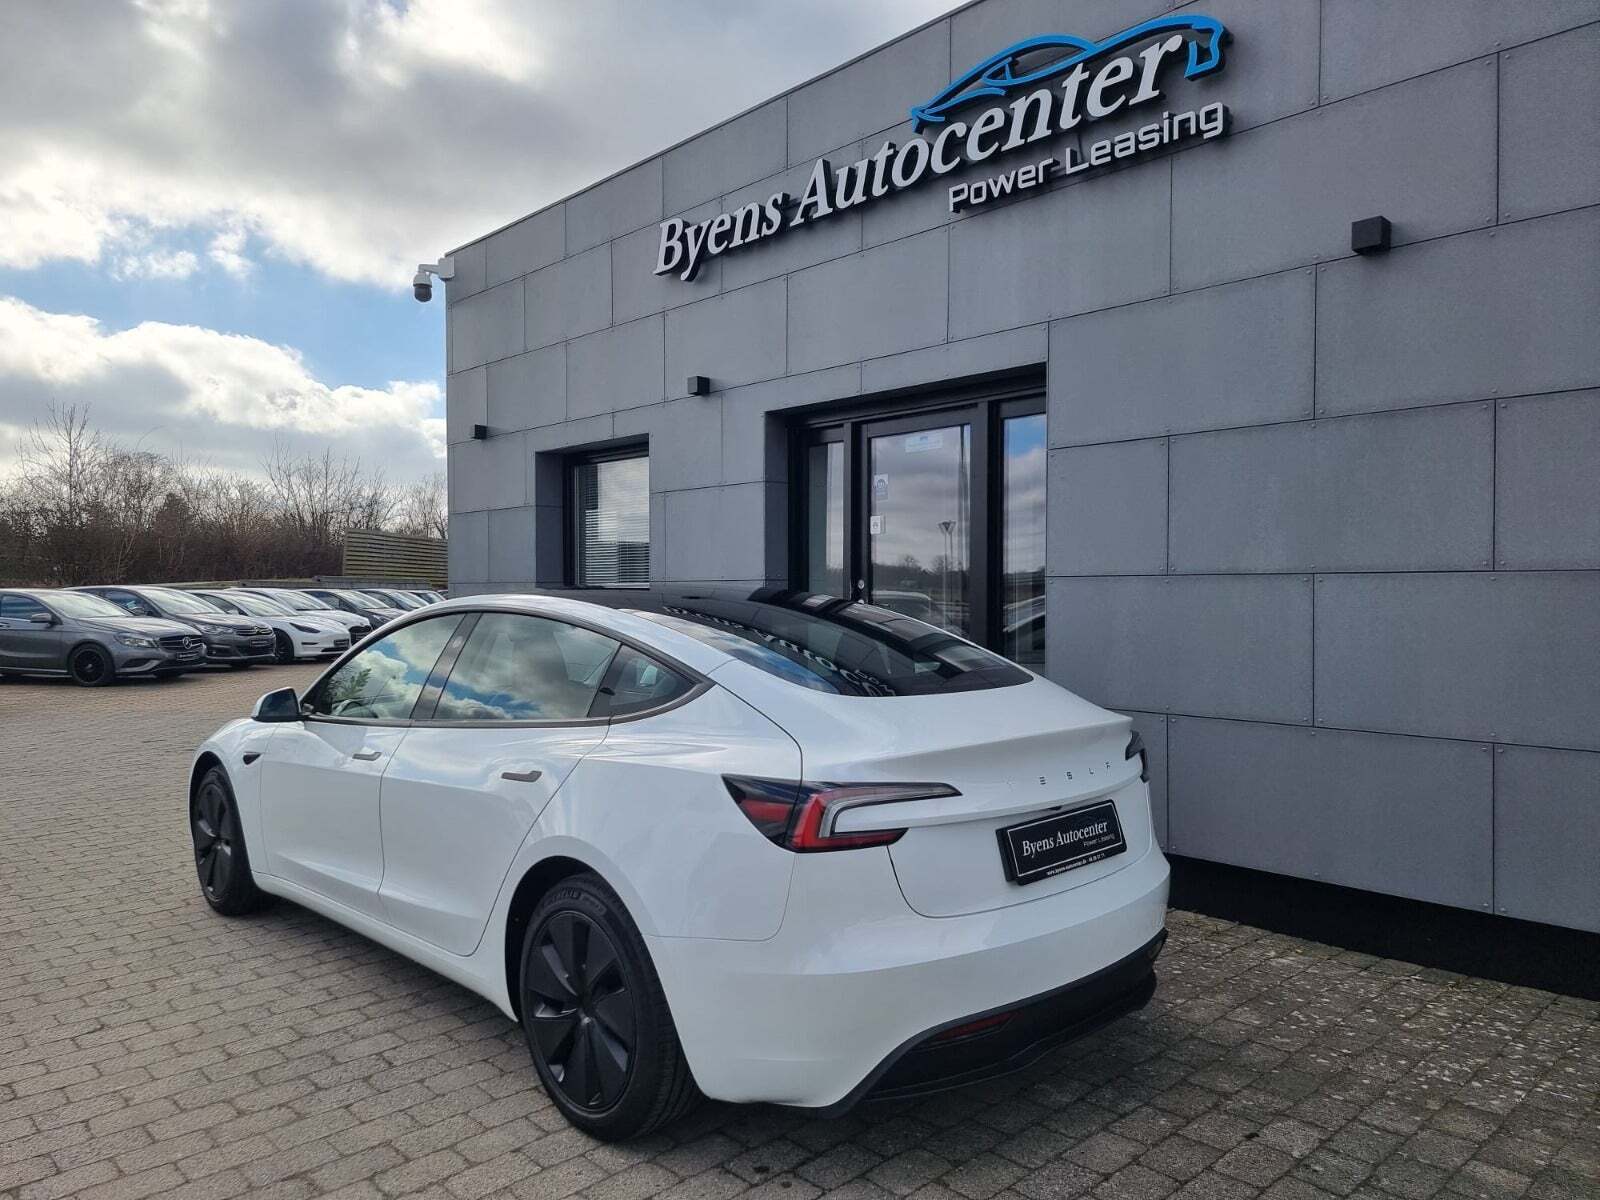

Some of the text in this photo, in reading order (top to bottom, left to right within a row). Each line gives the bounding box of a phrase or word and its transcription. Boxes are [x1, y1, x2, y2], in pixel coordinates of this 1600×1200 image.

[653, 34, 1184, 281] Byens Autocenter
[948, 102, 1226, 213] Power Leasing
[1022, 835, 1054, 858] Byens
[1056, 820, 1109, 847] Autocenter
